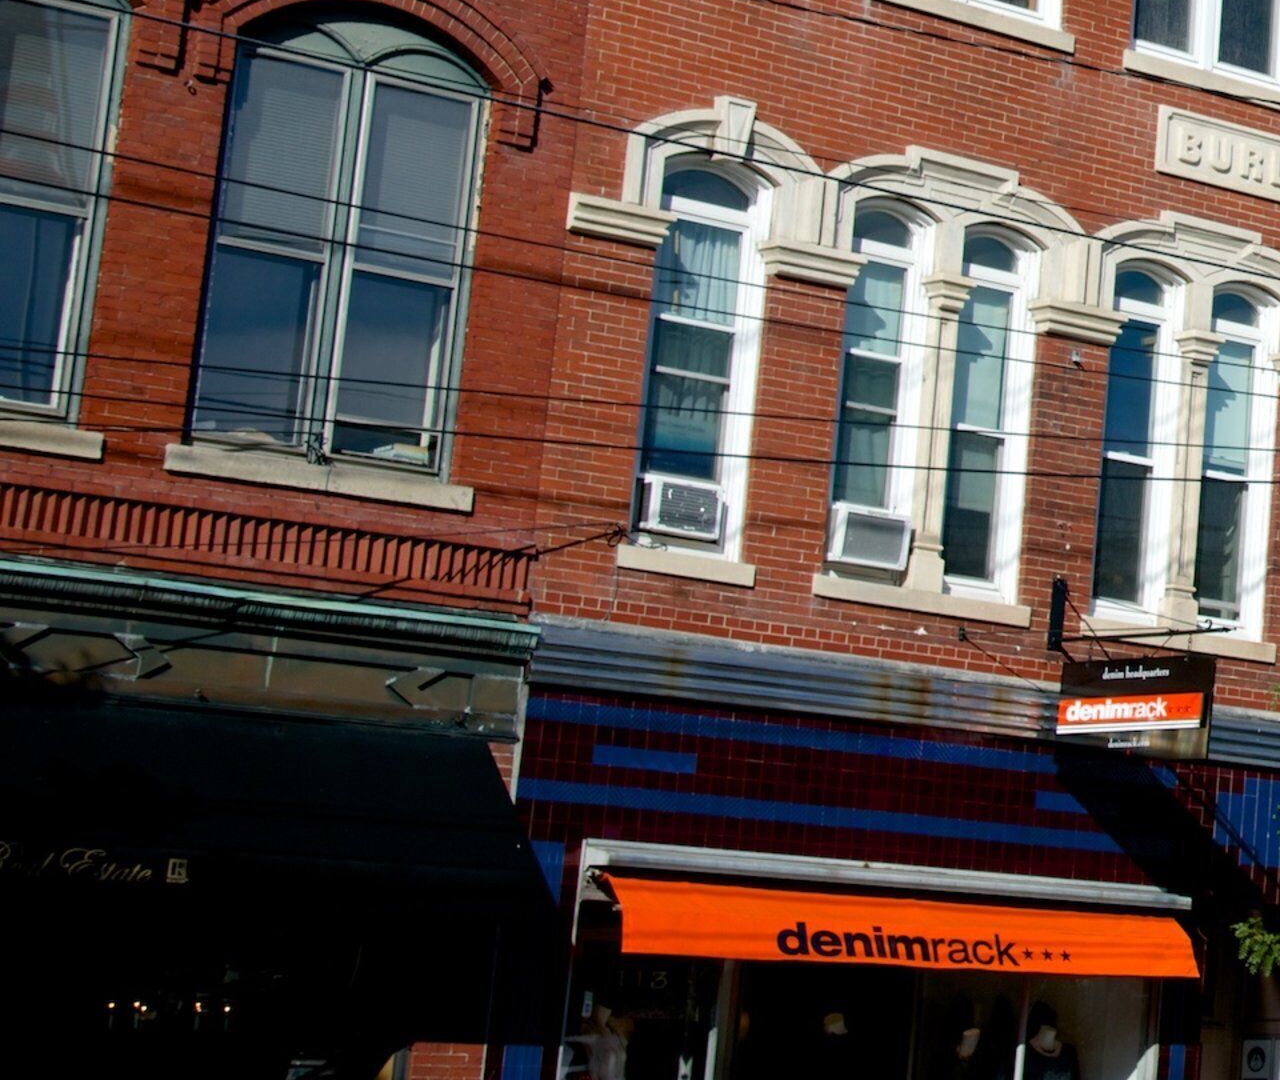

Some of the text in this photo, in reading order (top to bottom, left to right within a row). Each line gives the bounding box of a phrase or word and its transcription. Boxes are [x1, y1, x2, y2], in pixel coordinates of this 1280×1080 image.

[1102, 665, 1170, 680] denim headquarters
[1066, 696, 1168, 722] denimrack
[59, 847, 153, 882] Estate
[777, 922, 1020, 967] denimrack
